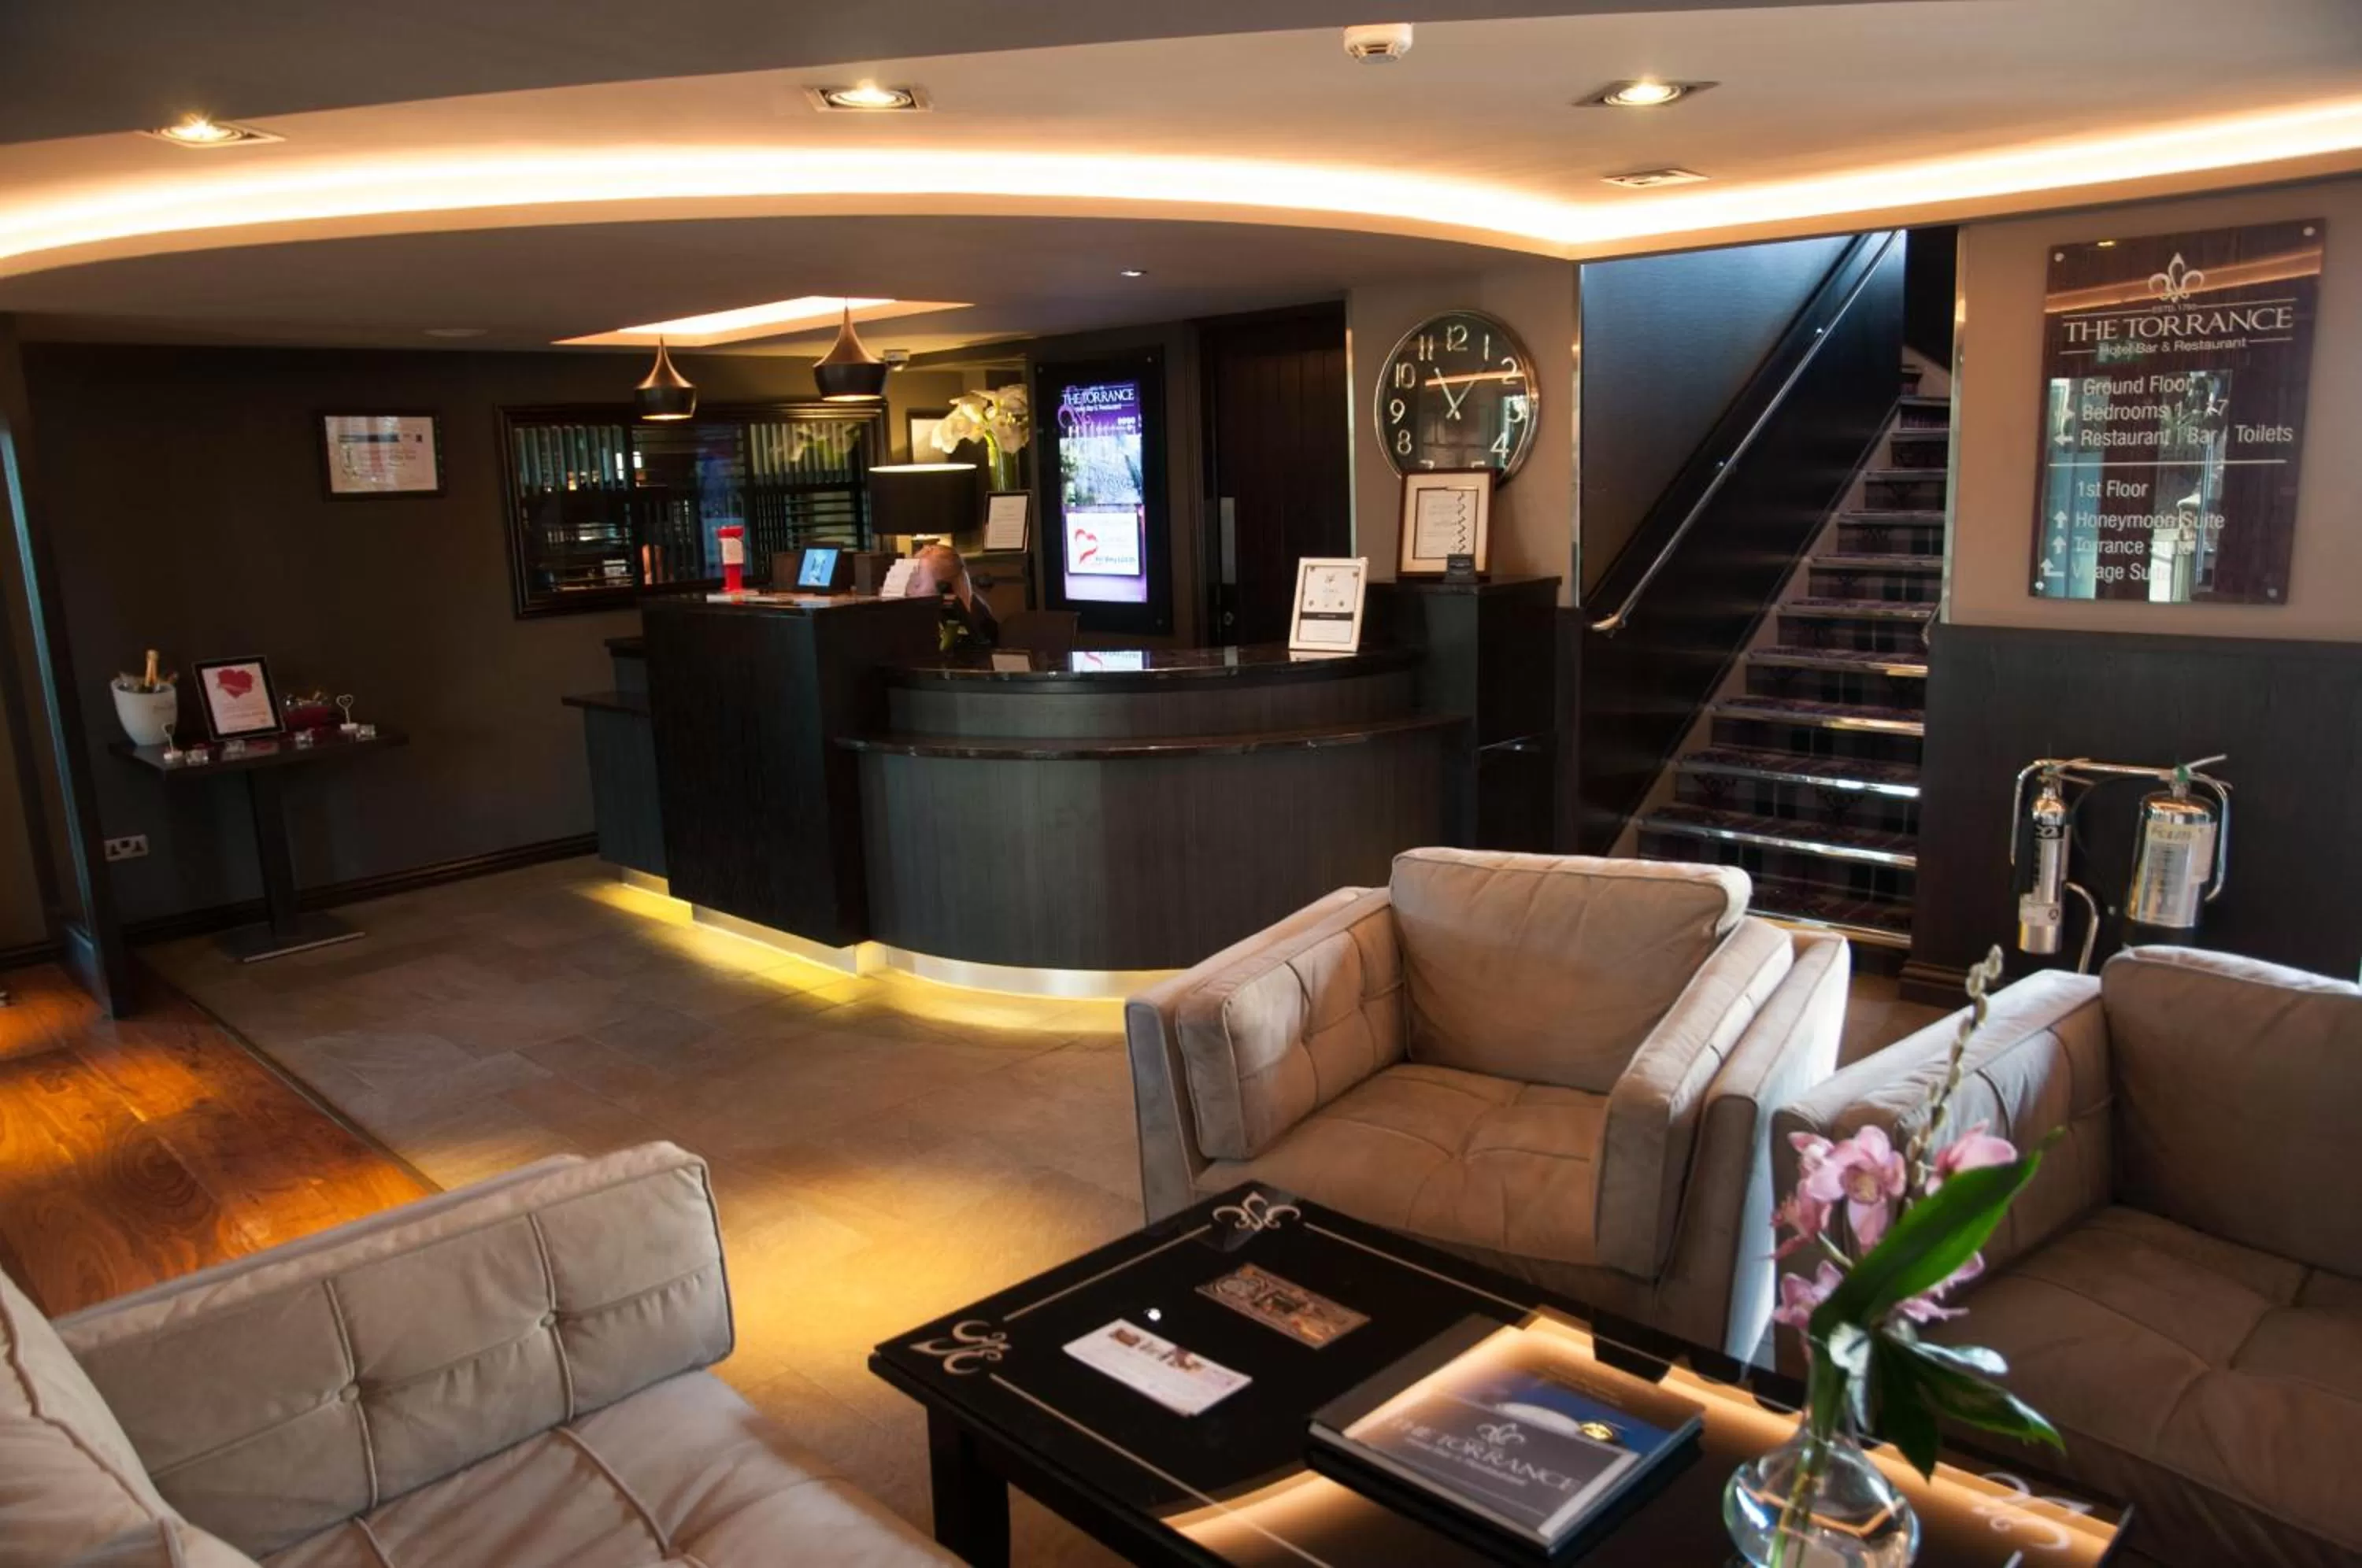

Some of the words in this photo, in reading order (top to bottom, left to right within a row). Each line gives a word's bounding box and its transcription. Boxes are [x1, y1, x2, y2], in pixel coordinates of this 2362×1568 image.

[2063, 320, 2118, 342] THE
[2123, 306, 2294, 338] TORRANCE
[1418, 335, 1434, 361] 11
[1446, 324, 1468, 352] 12
[1483, 334, 1490, 361] 1
[2174, 337, 2246, 352] Restaurant
[1395, 362, 1416, 389] 10
[1501, 357, 1518, 385] 2
[1083, 389, 1135, 403] TORRANCE
[2082, 375, 2144, 396] Ground
[2149, 375, 2194, 394] Floor
[1390, 398, 1405, 424] 9
[2082, 403, 2171, 421] Bedrooms
[1398, 429, 1412, 456] 8
[1490, 434, 1509, 460] 4
[2081, 429, 2171, 447] Restaurant
[2187, 426, 2219, 444] Bar
[2234, 423, 2294, 443] Toilets
[2078, 480, 2101, 498] 1st
[2106, 479, 2149, 498] Floor
[2075, 511, 2177, 531] Honeymoon
[2074, 536, 2144, 555] Torance
